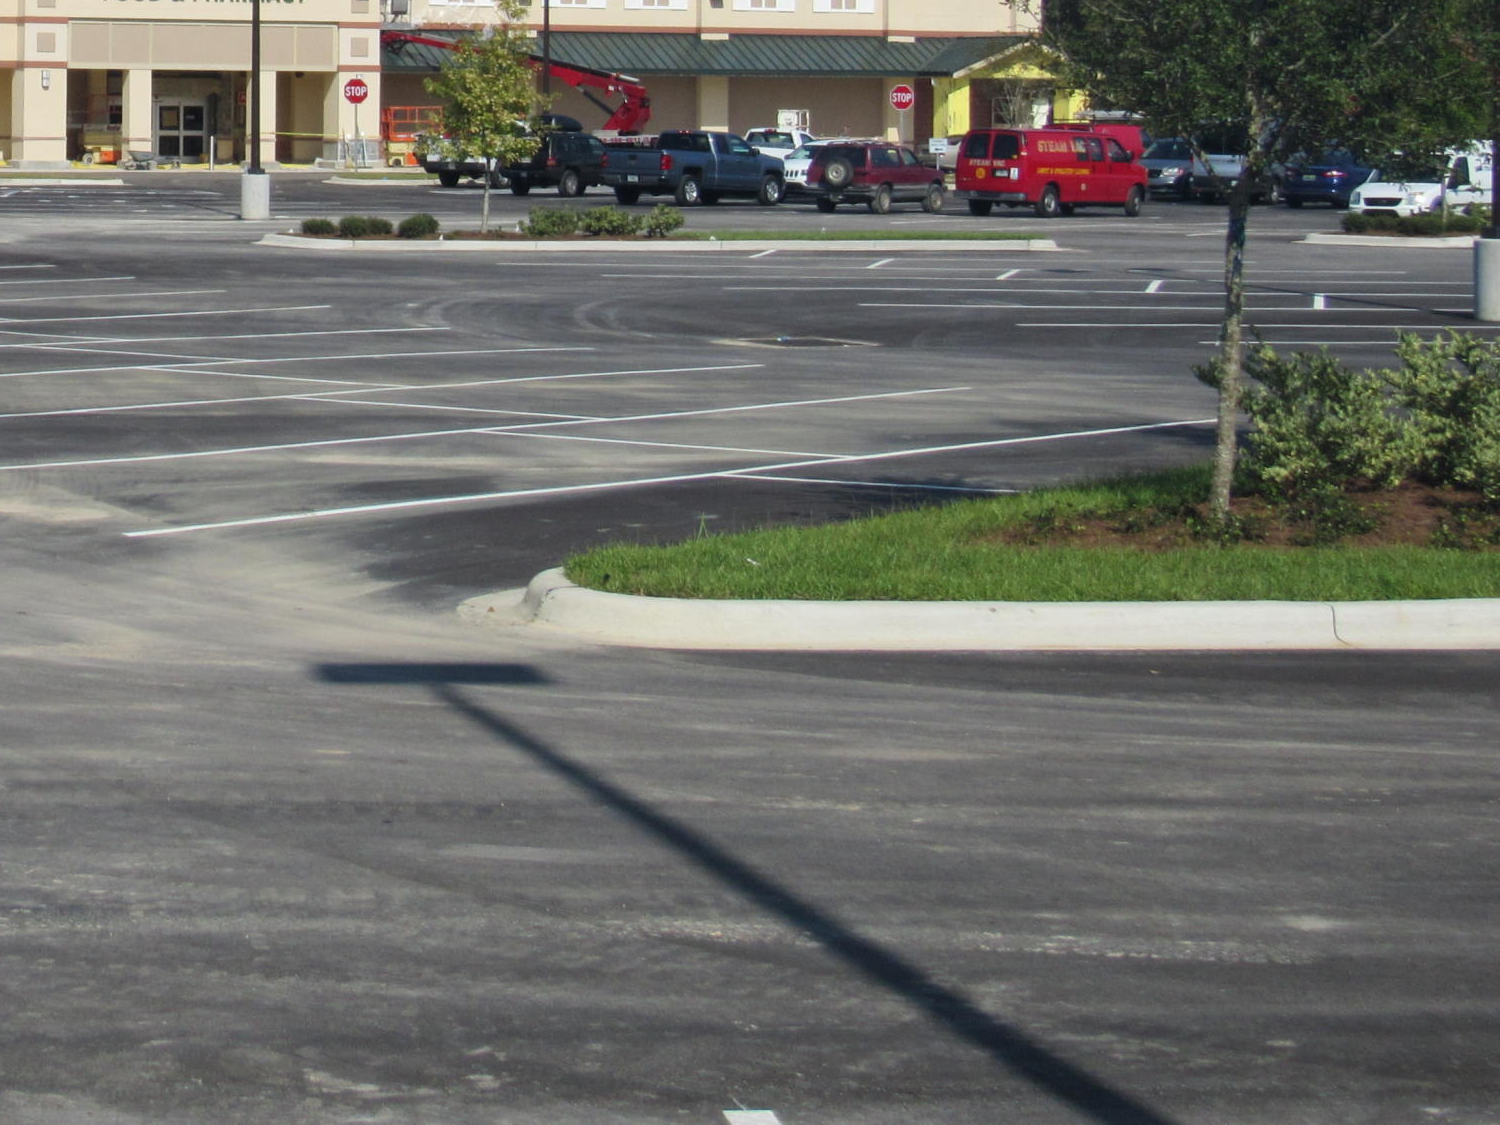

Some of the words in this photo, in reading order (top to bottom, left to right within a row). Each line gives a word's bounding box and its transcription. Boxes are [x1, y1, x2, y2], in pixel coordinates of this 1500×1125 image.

[345, 86, 367, 97] STOP
[892, 93, 912, 103] STOP
[1037, 140, 1067, 153] STEAM
